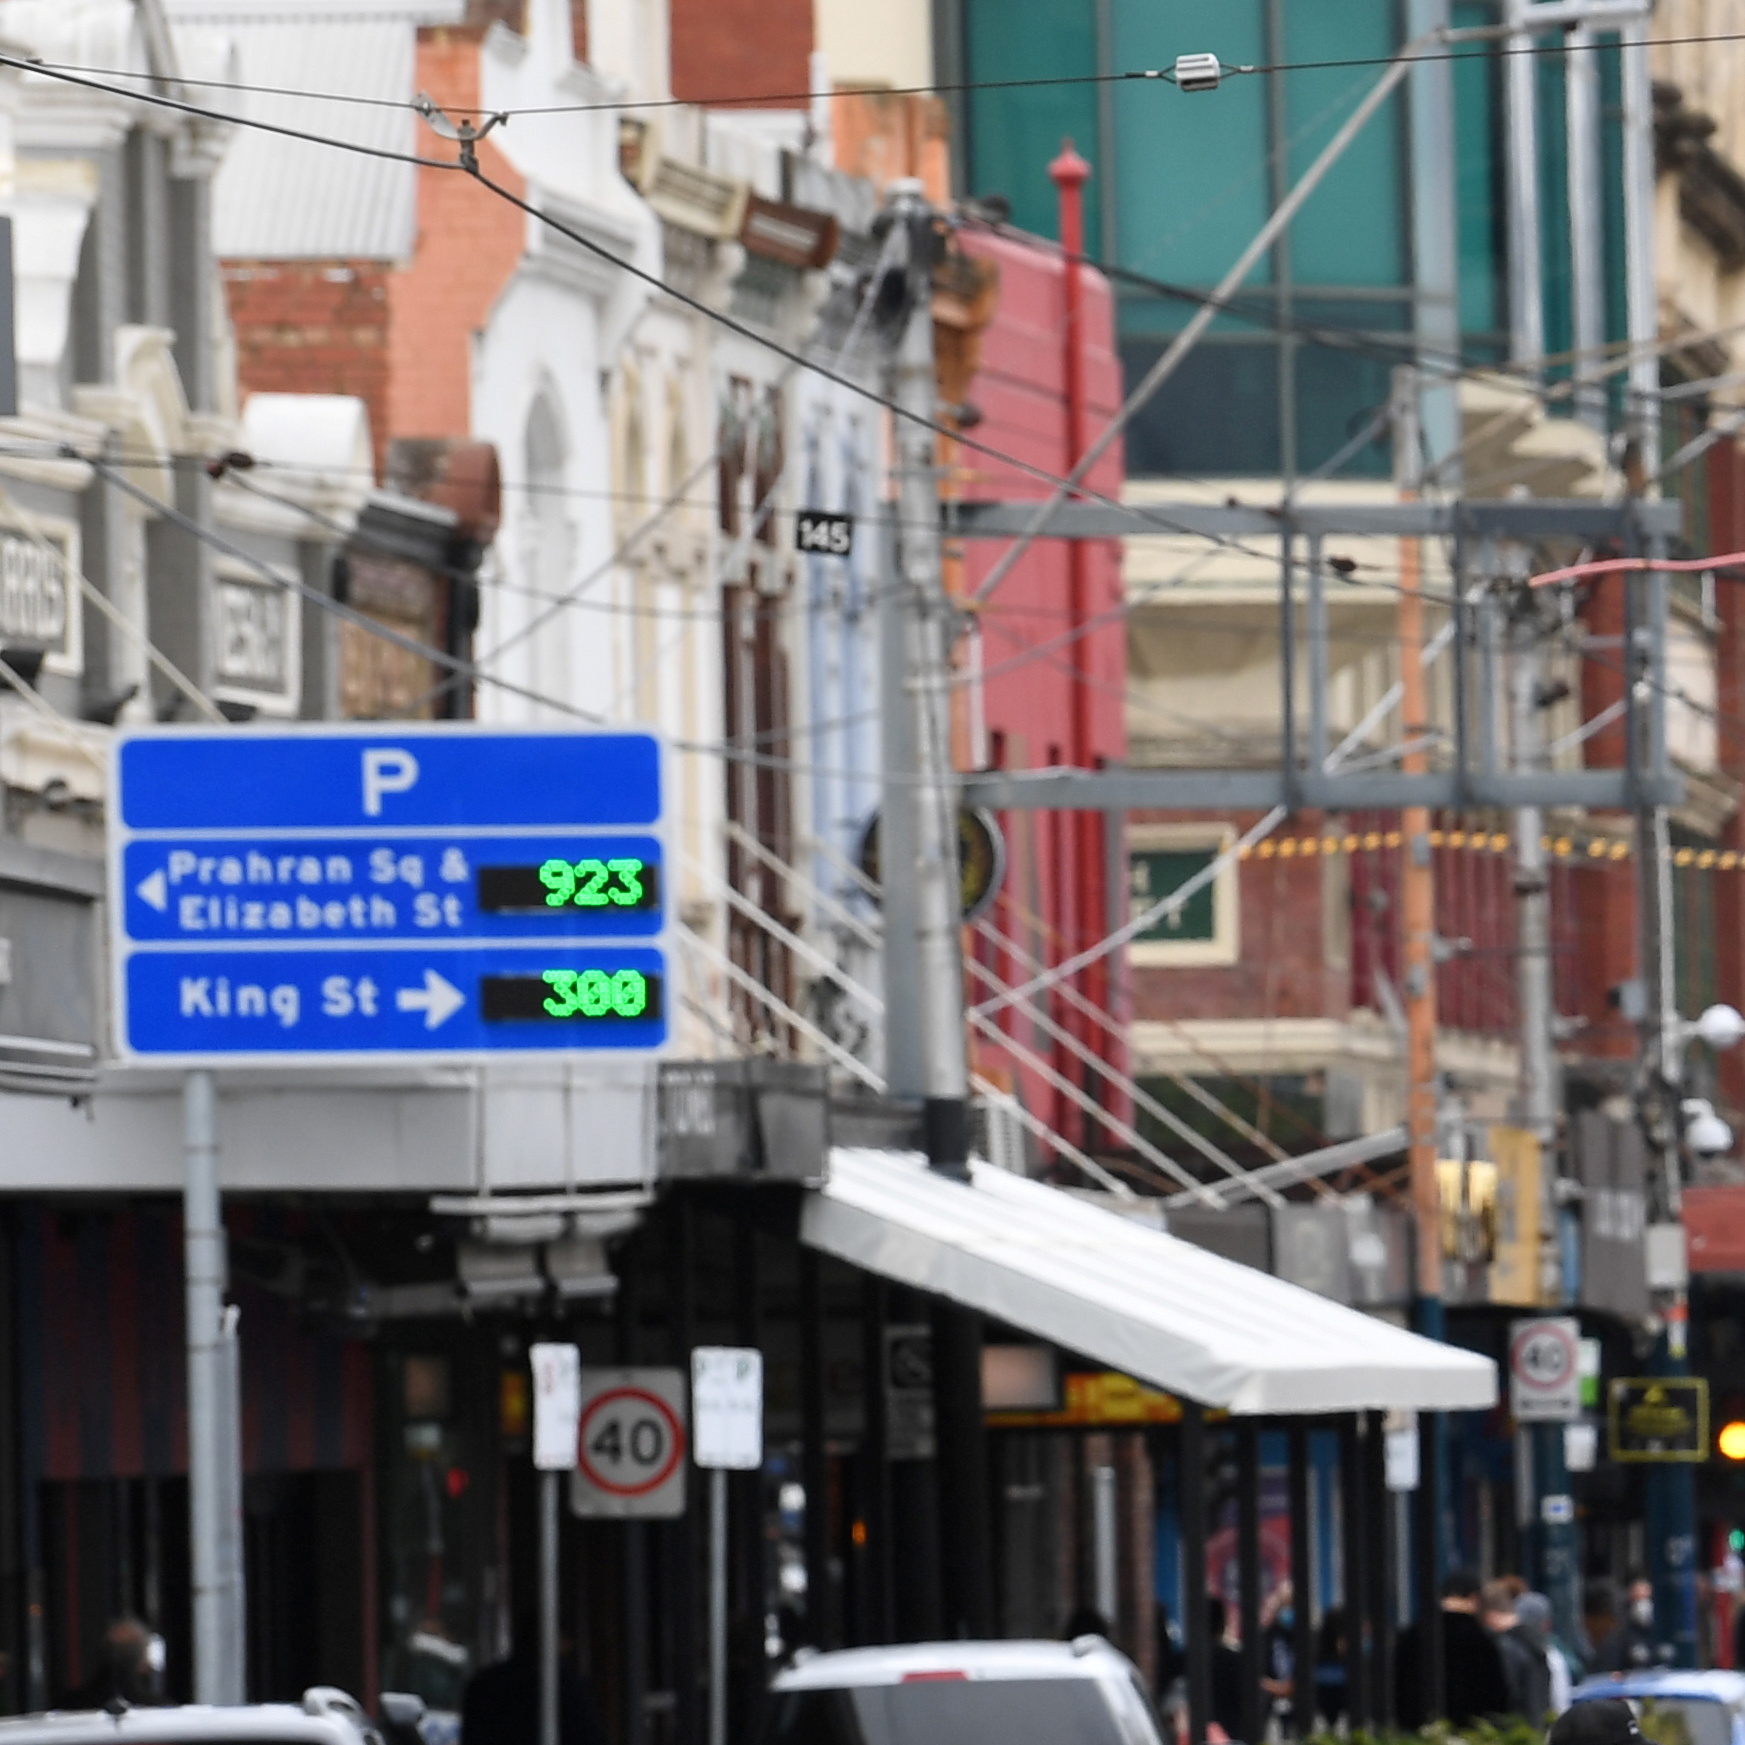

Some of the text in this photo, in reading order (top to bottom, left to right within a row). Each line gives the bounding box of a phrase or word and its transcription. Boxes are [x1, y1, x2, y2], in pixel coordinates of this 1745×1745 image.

[801, 518, 850, 553] 145
[361, 747, 419, 816] P
[168, 846, 469, 888] Prahran Sq &
[539, 859, 643, 906] 923
[179, 893, 462, 930] Elizabeth St
[180, 975, 379, 1028] King St
[543, 970, 646, 1016] 300
[591, 1418, 663, 1465] 40
